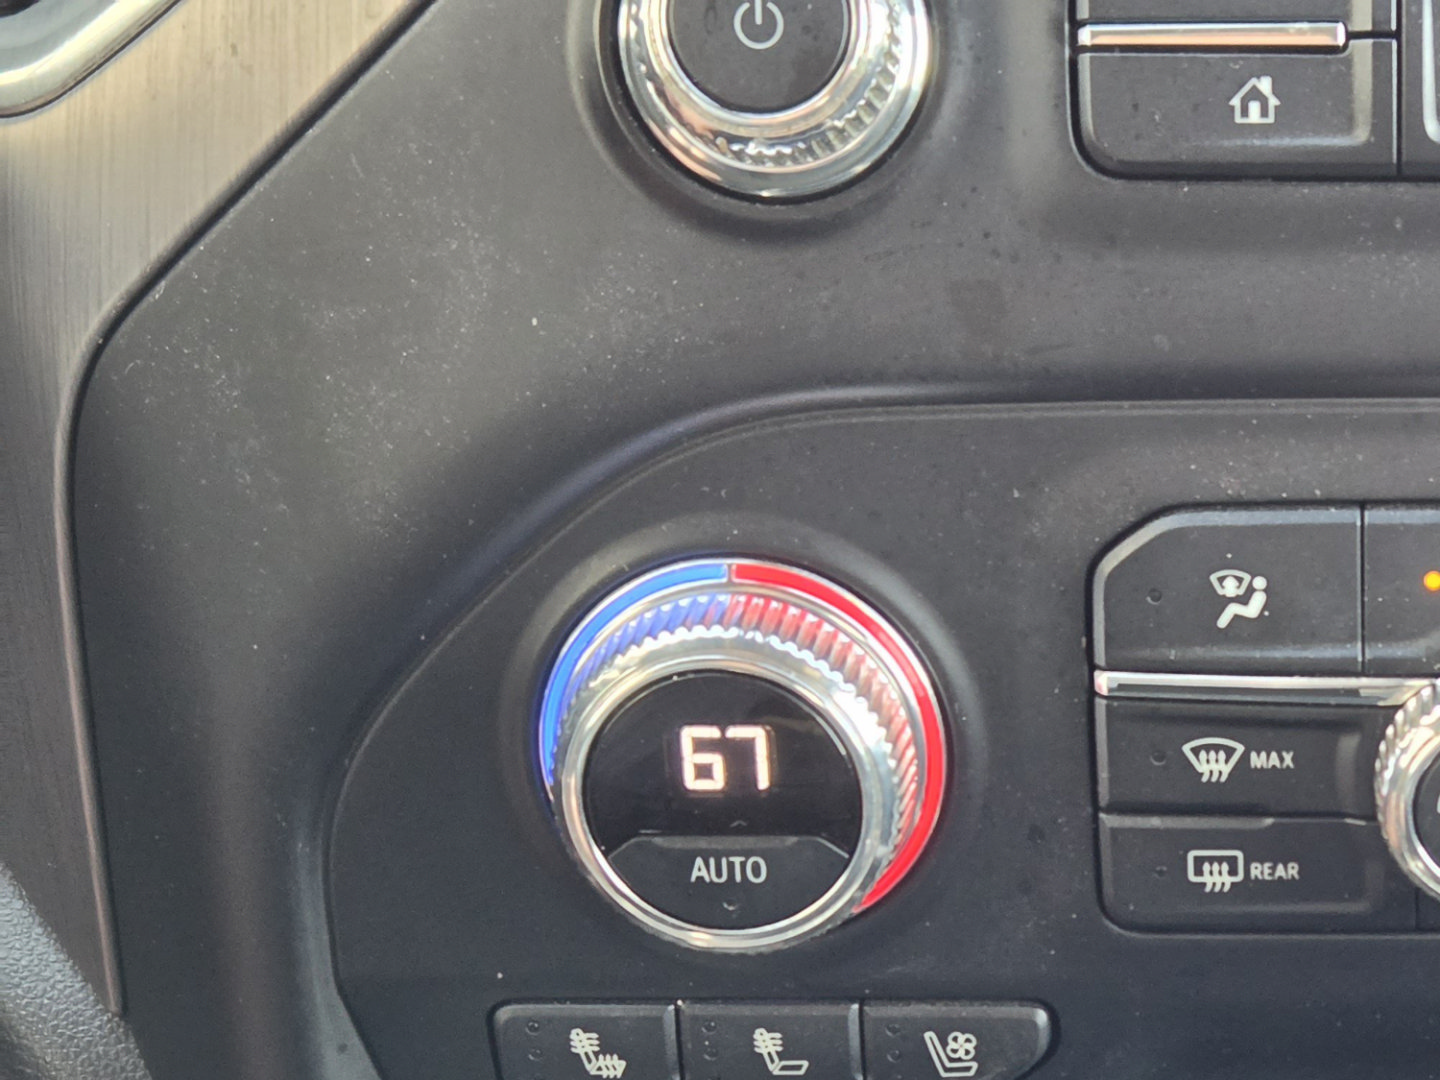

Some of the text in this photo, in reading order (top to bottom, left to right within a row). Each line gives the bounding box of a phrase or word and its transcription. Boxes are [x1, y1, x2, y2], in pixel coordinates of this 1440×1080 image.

[679, 723, 772, 791] 67
[1250, 750, 1294, 769] MAX
[690, 856, 767, 884] AUTO
[1250, 861, 1300, 881] REAR
